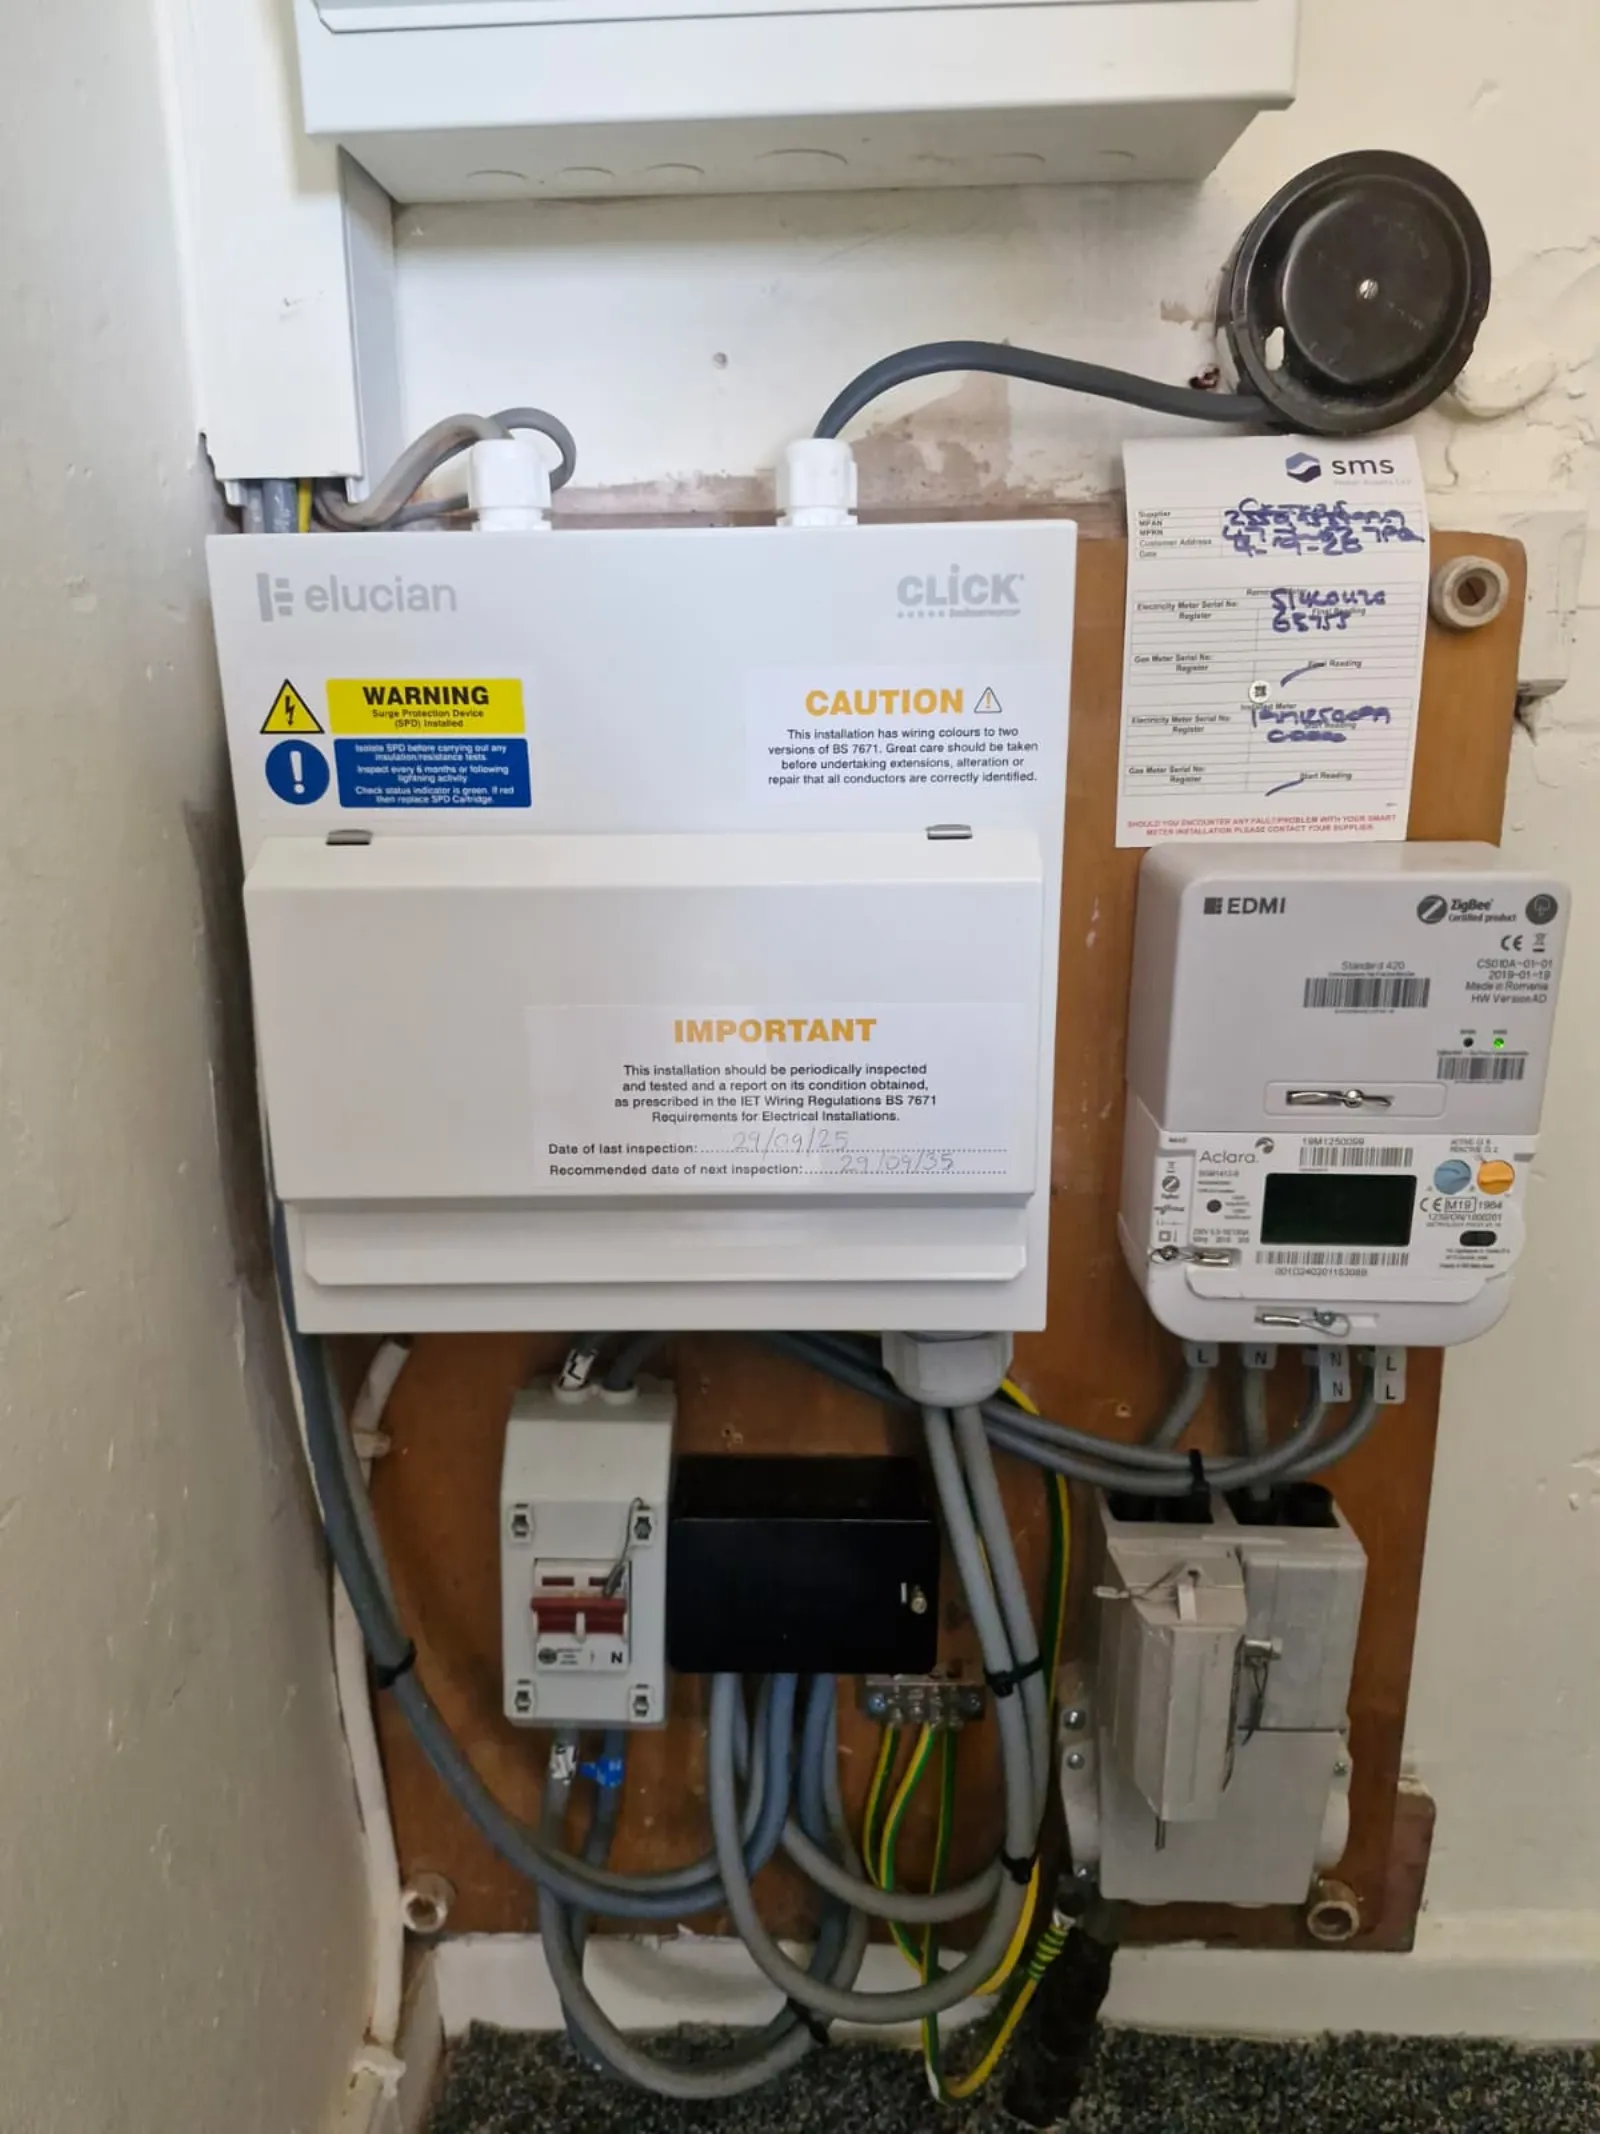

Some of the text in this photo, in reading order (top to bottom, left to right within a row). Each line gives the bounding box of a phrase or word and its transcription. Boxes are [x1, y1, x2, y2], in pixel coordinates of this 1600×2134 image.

[1332, 459, 1394, 475] sms
[304, 574, 457, 612] elucian
[363, 686, 489, 705] WARNING
[805, 688, 964, 717] CAUTION
[372, 709, 484, 719] Surge Protection Device
[395, 719, 464, 729] (SPD) Installed
[787, 727, 1019, 740] This installation has wiring colours to two
[387, 744, 405, 752] SPD
[407, 744, 436, 752] before
[438, 745, 473, 754] carrying
[491, 746, 507, 754] any
[768, 741, 1039, 755] versions of BS 7671. Great care should be taken
[357, 765, 389, 775] Inspect
[391, 767, 414, 775] every
[424, 765, 457, 773] months
[470, 765, 509, 775] following
[781, 757, 1025, 771] before undertaking extensions, alteration or
[437, 774, 468, 784] activity
[768, 771, 1037, 787] repair that all conductors are correctly identified.
[355, 786, 382, 795] Check
[385, 787, 411, 795] status
[413, 786, 450, 795] indicator
[453, 787, 461, 795] is
[499, 787, 514, 795] red
[376, 796, 395, 804] then
[397, 796, 430, 805] replace
[431, 796, 450, 804] SPD
[1227, 897, 1286, 914] EDMI
[1451, 899, 1491, 913] ZigBee
[1449, 913, 1516, 923] Certified product
[1501, 935, 1523, 951] CE
[1342, 961, 1384, 971] Standard
[1465, 981, 1494, 990] Made
[1505, 981, 1548, 991] Romania
[1472, 994, 1490, 1003] HW
[674, 1018, 877, 1043] IMPORTANT
[624, 1064, 927, 1077] This installation should be periodically inspected
[622, 1079, 928, 1093] and tested and a report on its condition obtained,
[615, 1095, 936, 1109] as prescribed in the IET Wiring Regulations BS 7671
[652, 1110, 900, 1124] Requirements for Electrical Installations.
[733, 1127, 848, 1158] 29/09/25
[549, 1143, 697, 1157] Date of last inspection:
[1200, 1150, 1256, 1164] Aclara
[550, 1163, 803, 1177] Recommended date of next inspection:
[1198, 1350, 1208, 1364] L
[1254, 1351, 1266, 1365] N
[1330, 1352, 1341, 1367] N
[1387, 1356, 1397, 1371] L
[1333, 1381, 1343, 1397] N
[1386, 1385, 1396, 1400] L
[611, 1651, 623, 1664] N
